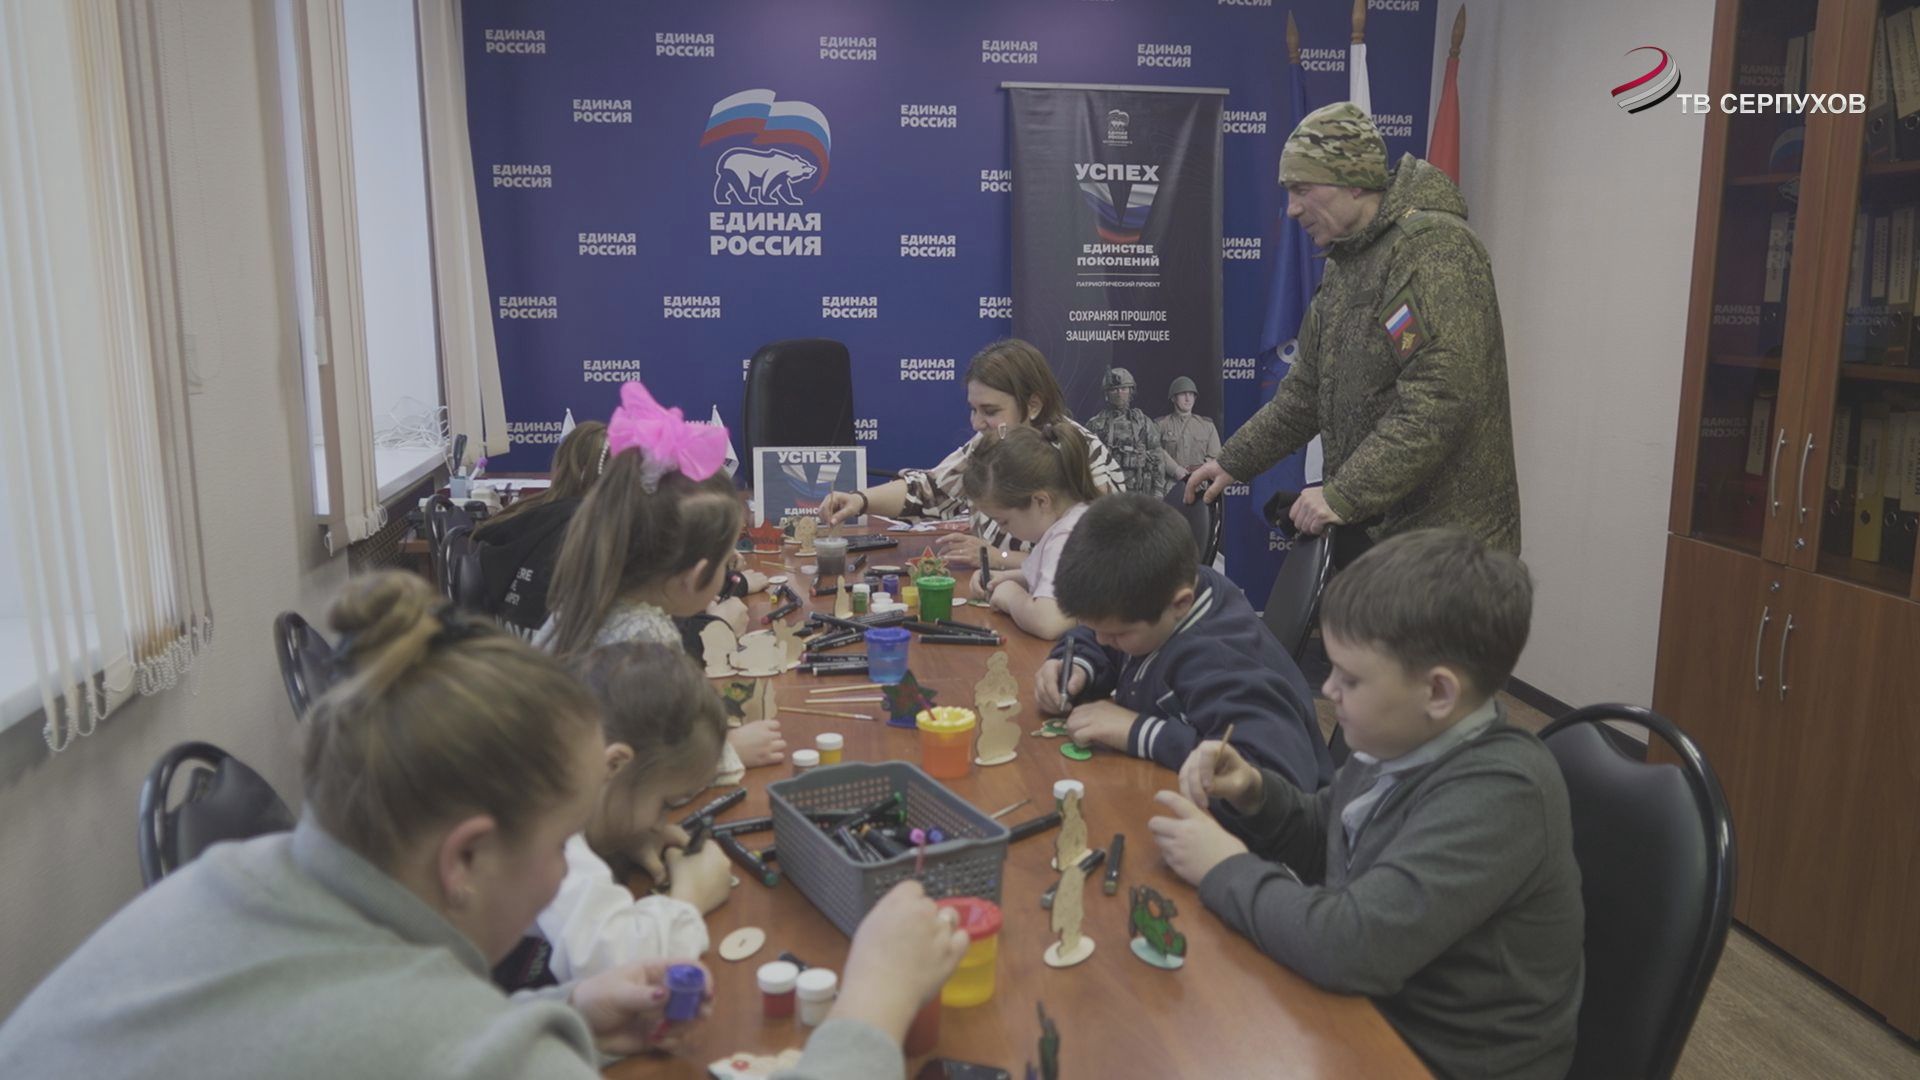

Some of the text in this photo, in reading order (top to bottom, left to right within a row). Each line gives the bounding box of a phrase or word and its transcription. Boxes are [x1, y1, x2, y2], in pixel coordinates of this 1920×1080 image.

[1368, 0, 1419, 10] РОССИЯ
[486, 30, 545, 40] ЕДИНАЯ
[656, 33, 714, 44] ЕДИНАЯ
[820, 37, 876, 47] ЕДИНАЯ
[983, 40, 1037, 51] ЕДИНАЯ
[487, 42, 545, 53] РОССИЯ
[657, 45, 714, 56] РОССИЯ
[1138, 44, 1191, 55] ЕДИНАЯ
[820, 49, 876, 60] РОССИЯ
[983, 52, 1037, 63] РОССИЯ
[1300, 49, 1345, 59] ДИНАЯ
[1138, 56, 1191, 67] РОССИЯ
[1301, 61, 1344, 71] ОССИЯ
[573, 100, 631, 110] ЕДИНАЯ
[901, 105, 956, 115] ЕДИНАЯ
[574, 112, 632, 122] РОССИЯ
[1223, 111, 1266, 121] ДИНАЯ
[901, 117, 956, 127] РОССИЯ
[1223, 123, 1266, 133] ОССИЯ
[1381, 126, 1412, 136] ССИЯ
[493, 165, 551, 175] ЕДИНАЯ
[981, 170, 1011, 180] ЕДИ
[1075, 163, 1159, 181] УСПЕХ
[494, 177, 552, 187] РОССИЯ
[981, 182, 1011, 192] РОС
[710, 212, 821, 233] ЕДИНАЯ
[579, 233, 636, 244] ЕДИНАЯ
[901, 235, 955, 245] ЕДИНАЯ
[1223, 238, 1261, 248] ИНАЯ
[579, 245, 636, 255] РОССИЯ
[711, 236, 821, 255] РОССИЯ
[1084, 244, 1153, 254] ЕДИНСТВЕ
[901, 247, 955, 257] РОССИЯ
[1223, 249, 1260, 259] ССИЯ
[1077, 255, 1160, 267] ПОКОЛЕНИЙ
[500, 297, 557, 307] ЕДИНАЯ
[664, 297, 720, 307] ЕДИНАЯ
[823, 297, 877, 307] ЕДИНАЯ
[980, 297, 1011, 307] ЕДИН
[500, 308, 557, 318] РОССИЯ
[664, 308, 720, 318] РОССИЯ
[823, 308, 877, 318] РОССИЯ
[980, 308, 1011, 318] РОСС
[1069, 311, 1166, 321] СОХРАНЯЯ ПРОШЛОЕ
[1066, 330, 1169, 341] ЗАЩИЩАЕМ БУДУЩЕЕ
[584, 360, 640, 370] ЕДИНАЯ
[901, 359, 954, 369] ЕДИНАЯ
[1223, 359, 1255, 367] ИНАЯ
[584, 371, 640, 382] РОССИЯ
[901, 370, 954, 380] РОССИЯ
[1223, 369, 1254, 379] ССИЯ
[777, 451, 841, 463] УСПЕХ
[1224, 485, 1250, 496] СИЯ
[785, 507, 817, 517] ЕДИНС
[1269, 541, 1294, 551] РОС
